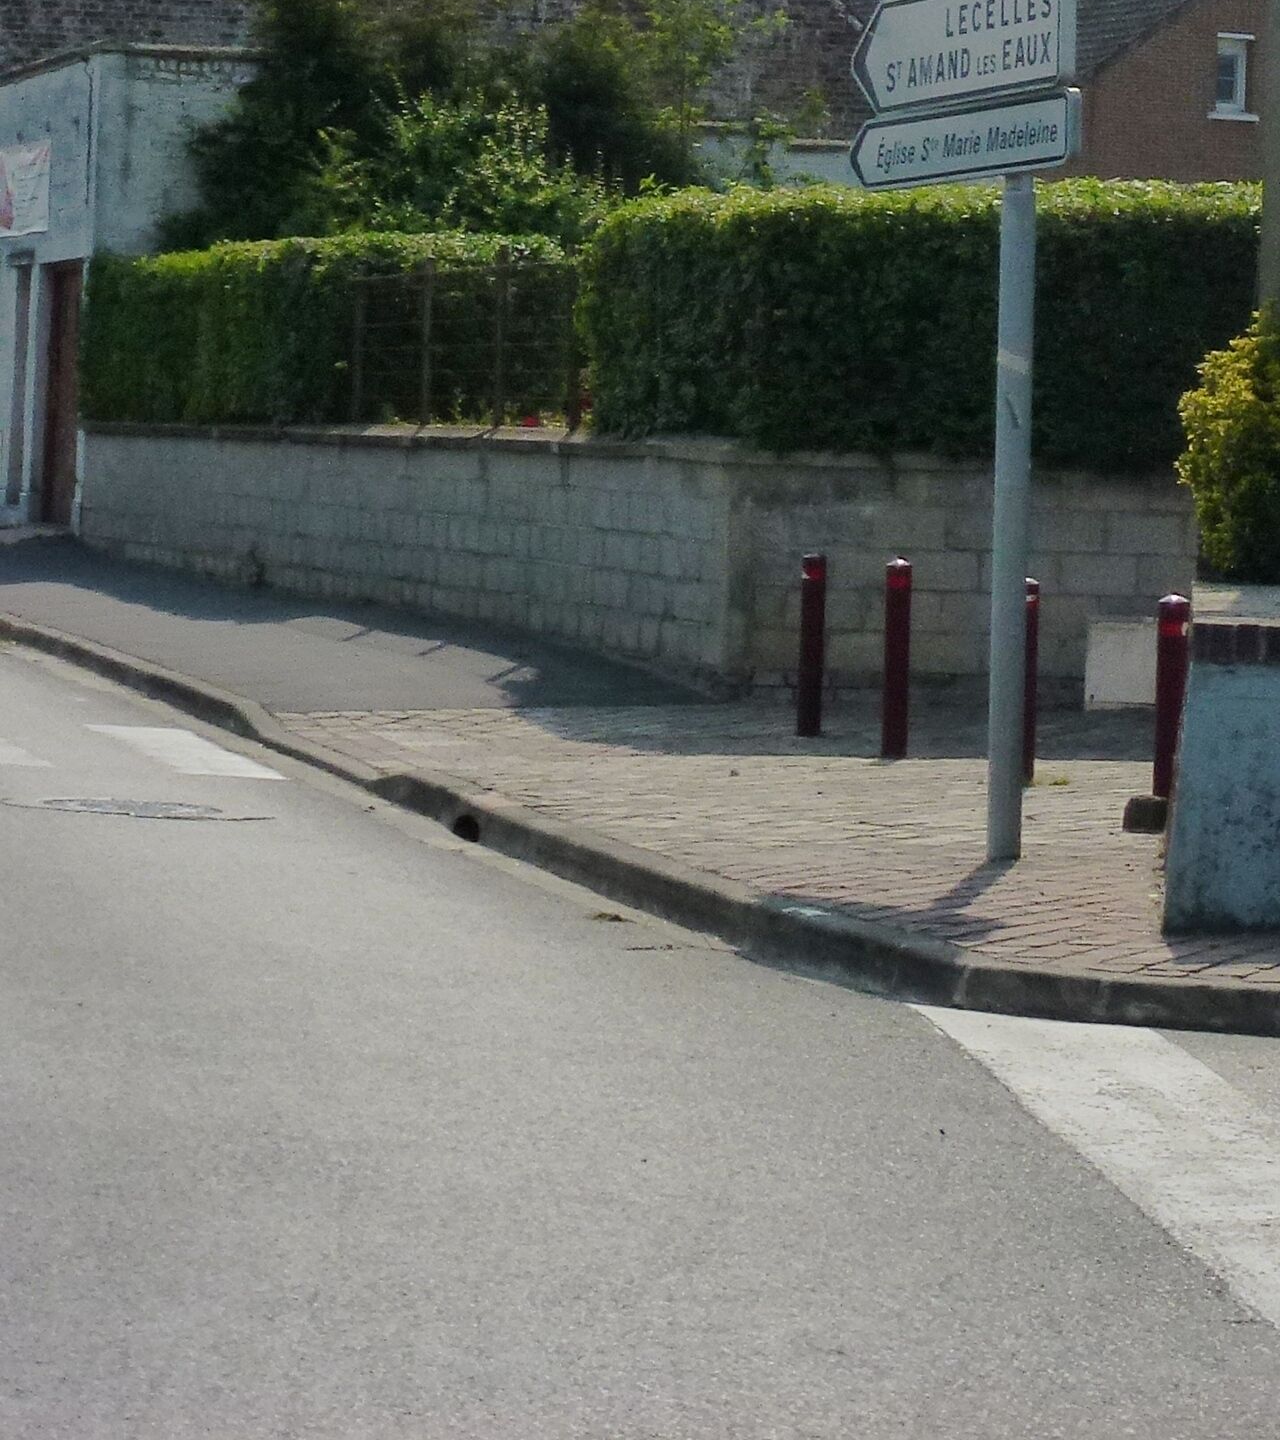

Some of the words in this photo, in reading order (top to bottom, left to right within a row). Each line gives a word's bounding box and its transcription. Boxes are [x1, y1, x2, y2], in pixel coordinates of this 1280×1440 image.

[907, 47, 971, 89] AMAND
[976, 54, 997, 77] LES
[1002, 31, 1052, 72] EAUX
[875, 137, 916, 174] Église
[942, 129, 981, 159] Marie
[986, 118, 1059, 153] Madeleine
